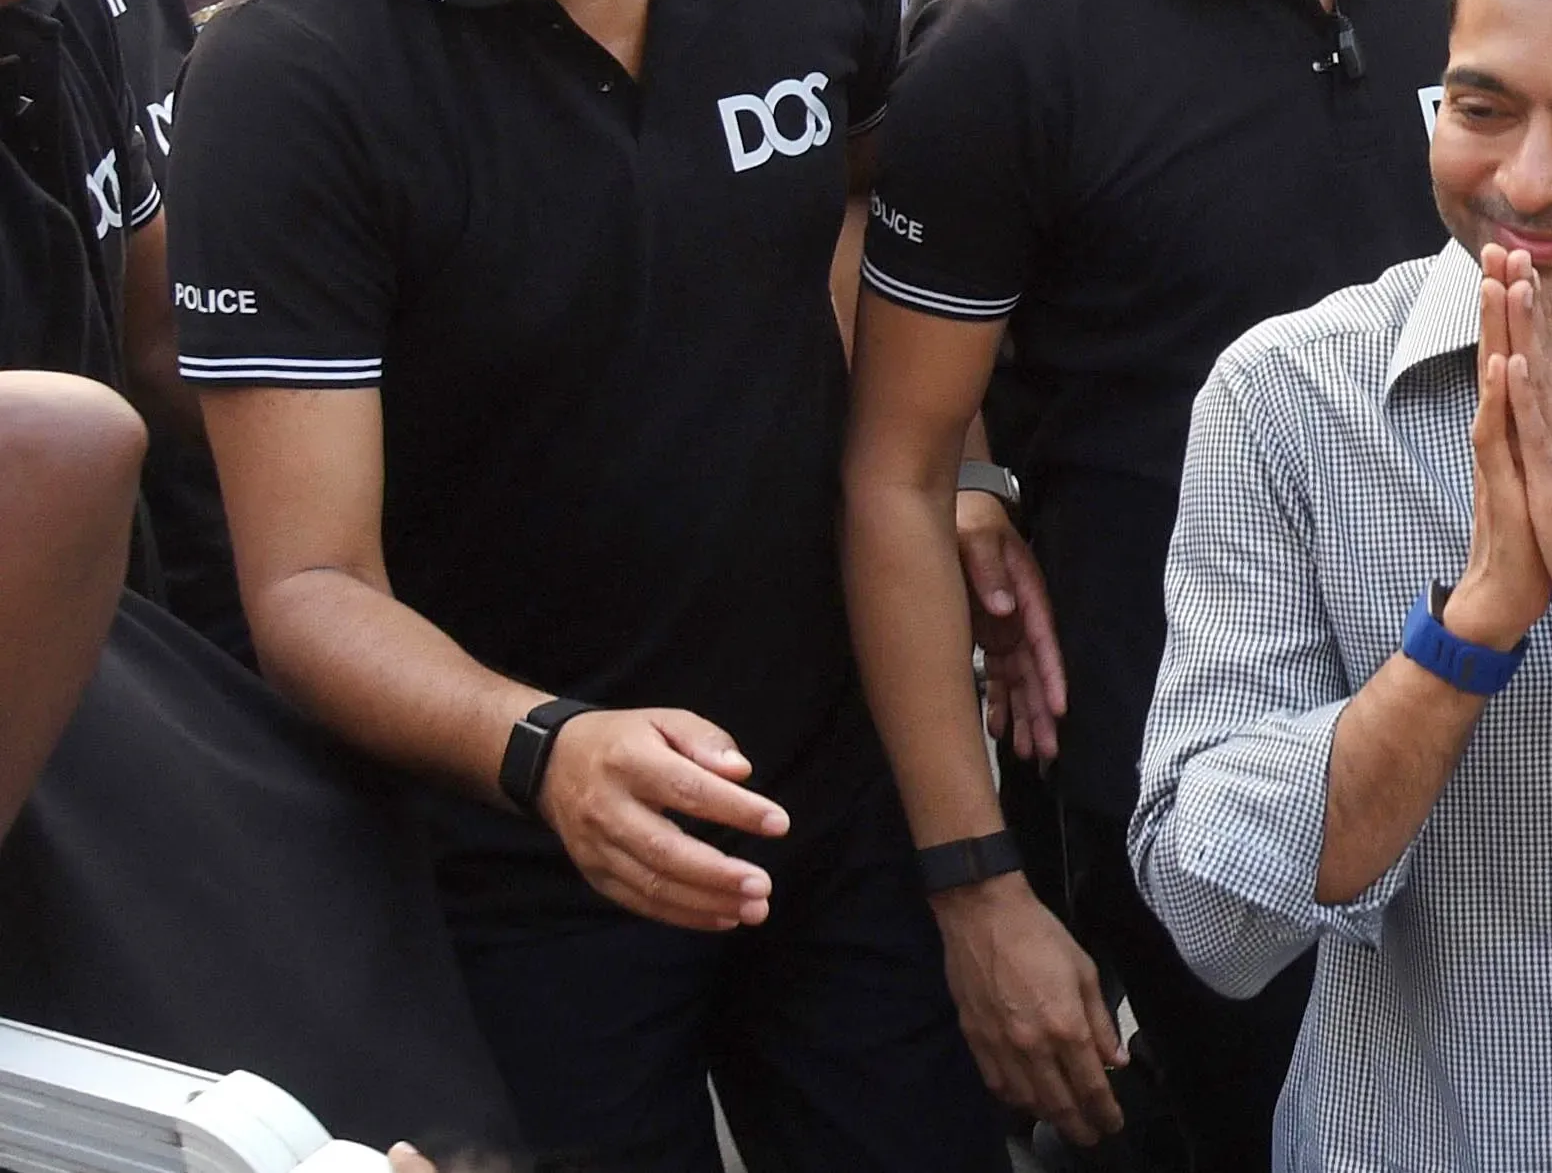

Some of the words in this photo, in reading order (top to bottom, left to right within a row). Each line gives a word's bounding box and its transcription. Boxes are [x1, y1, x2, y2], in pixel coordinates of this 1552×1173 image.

[717, 71, 832, 173] DOS
[871, 188, 924, 244] OLICE
[174, 282, 258, 314] POLICE
